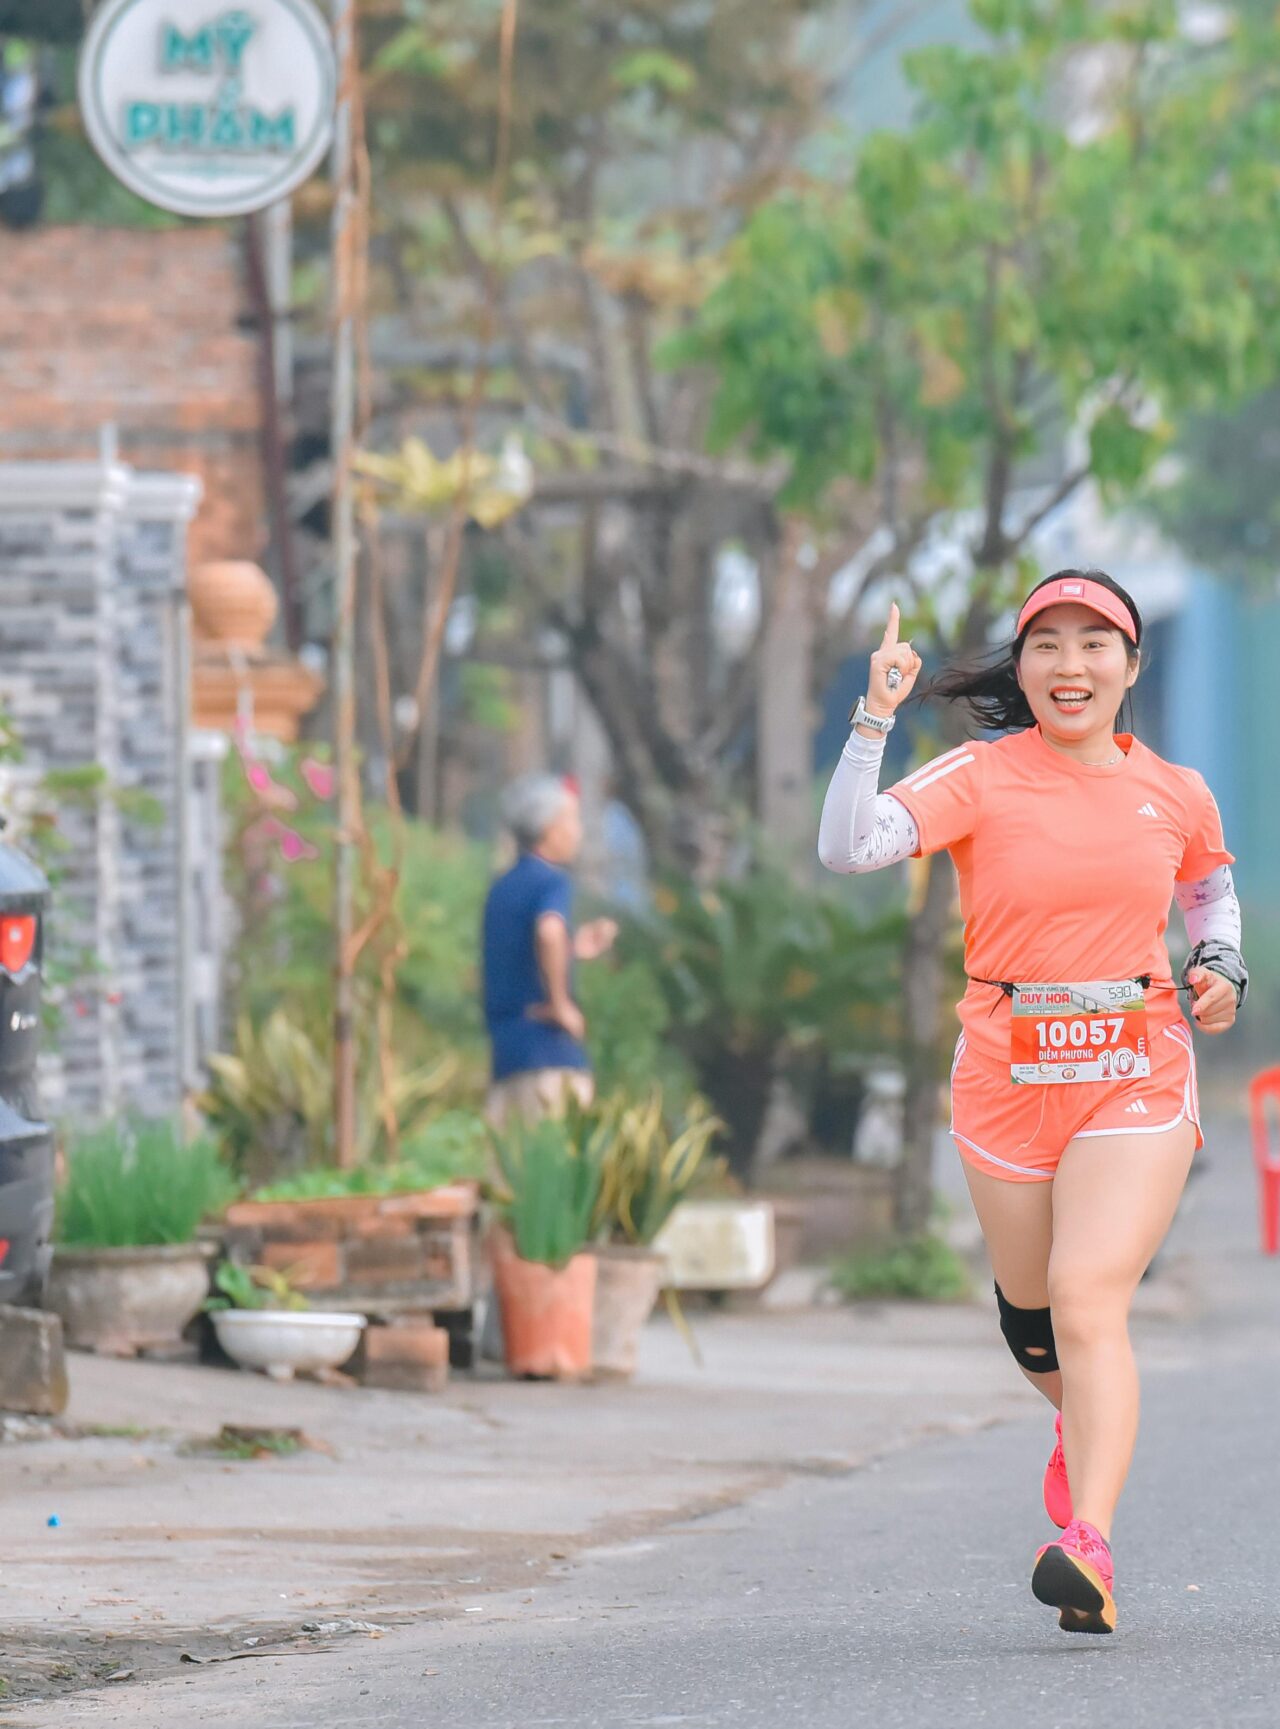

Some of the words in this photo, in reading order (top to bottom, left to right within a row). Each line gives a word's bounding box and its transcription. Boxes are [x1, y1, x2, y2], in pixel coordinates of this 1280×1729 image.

[164, 10, 254, 67] MỸ
[1020, 993, 1042, 1004] DUY
[1036, 1018, 1124, 1047] 10057
[1060, 1049, 1093, 1060] PHƯƠNG
[1137, 1037, 1146, 1057] km
[1098, 1047, 1135, 1078] 10
